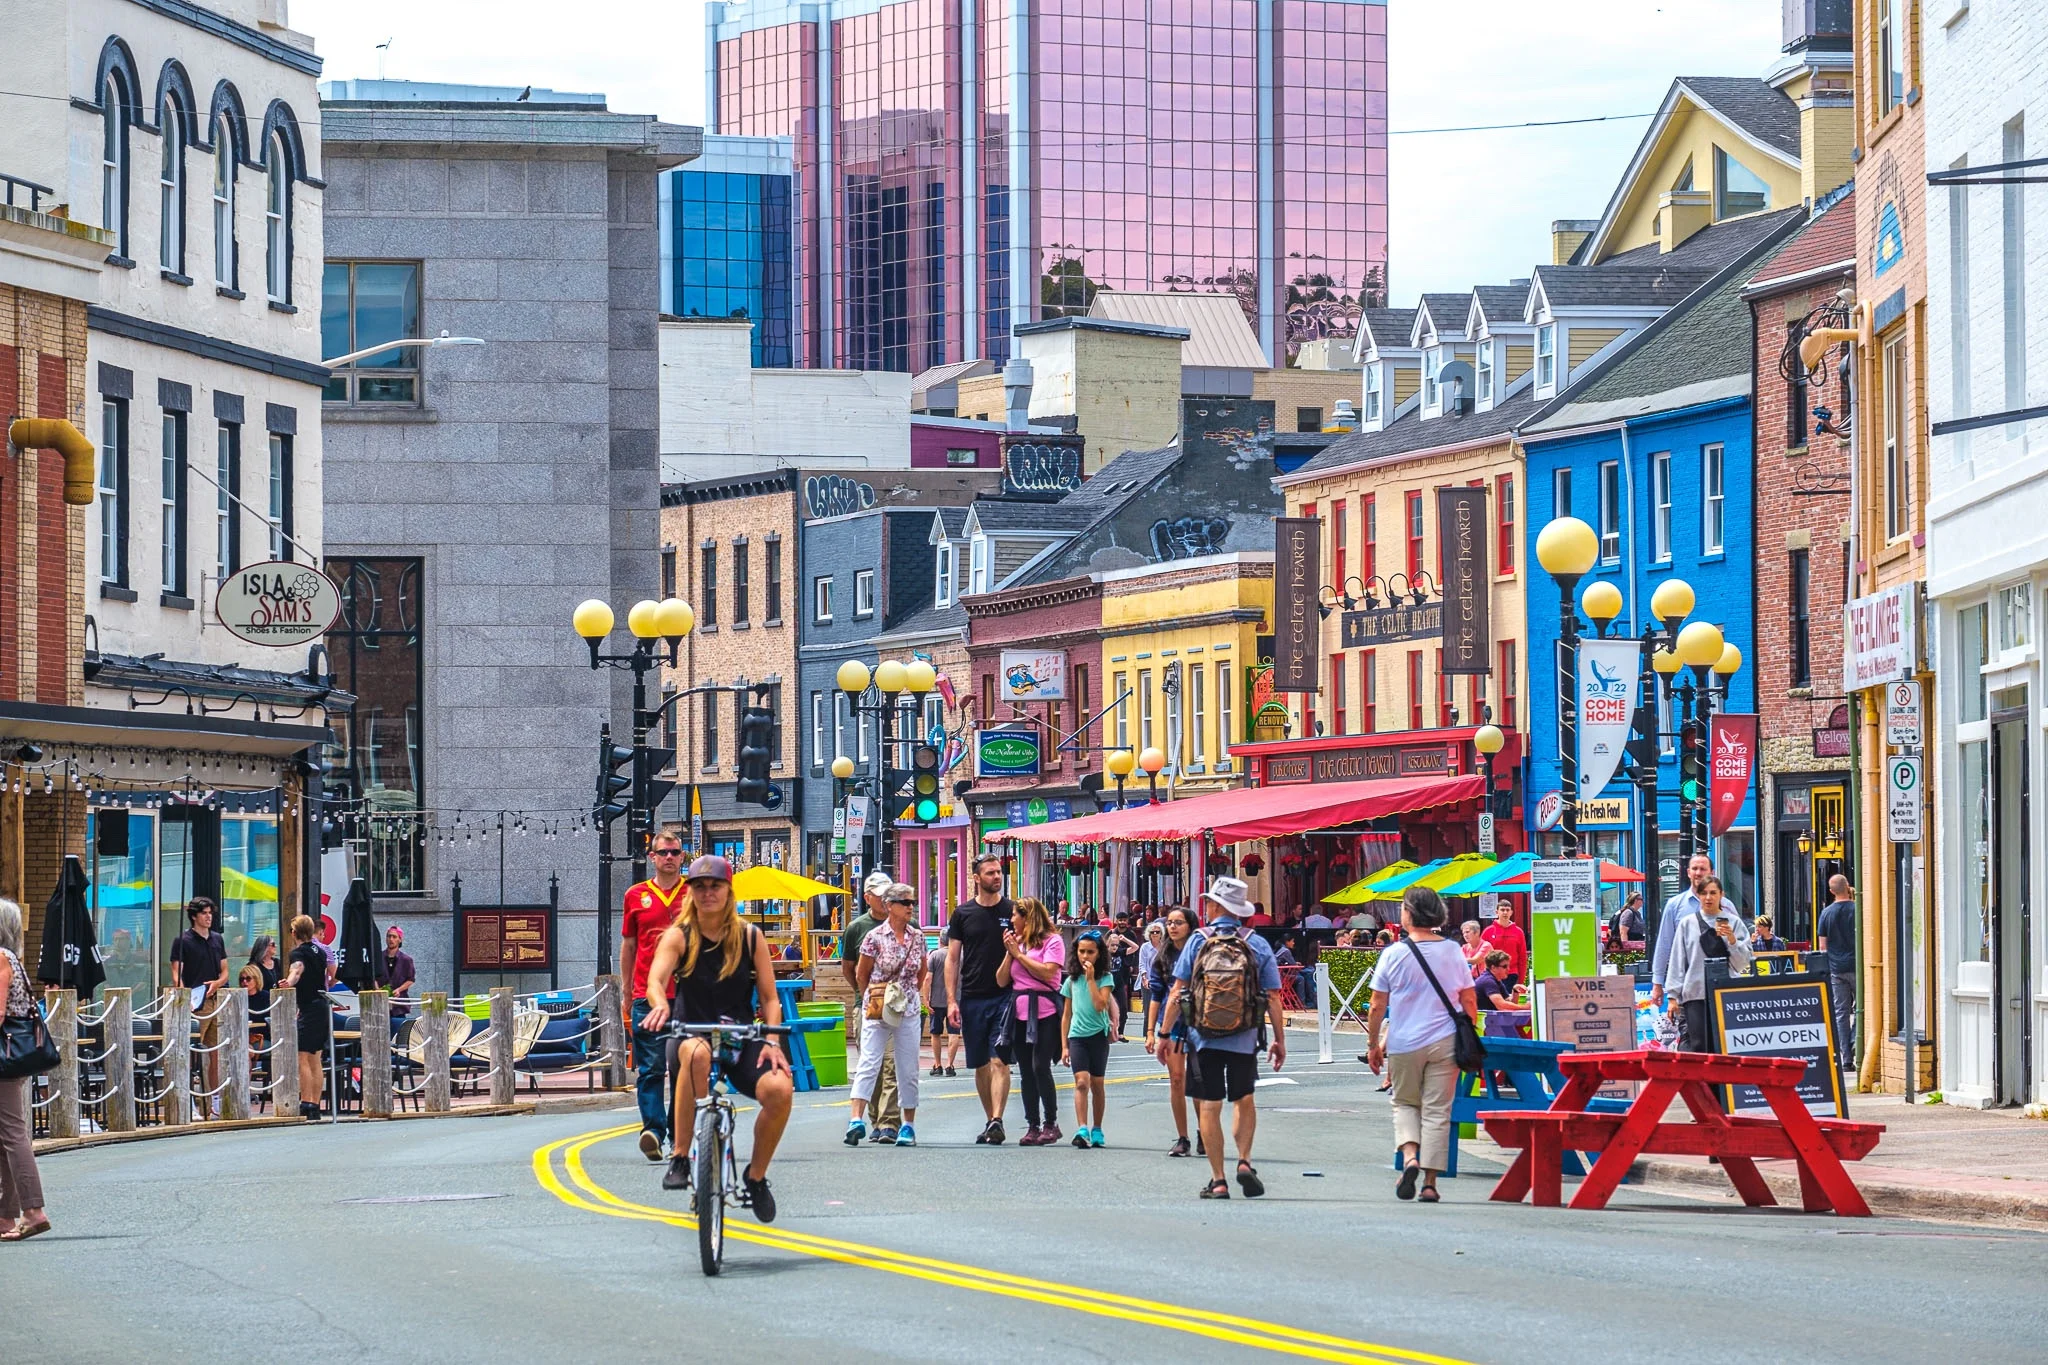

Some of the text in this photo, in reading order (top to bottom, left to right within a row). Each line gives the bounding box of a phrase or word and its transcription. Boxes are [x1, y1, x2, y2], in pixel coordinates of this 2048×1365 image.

[243, 574, 288, 601] ISLA
[251, 594, 312, 628] SAM'S
[1362, 607, 1441, 637] THE CELTIC HEARTH
[246, 626, 311, 635] Shoes & Fashion
[1586, 683, 1627, 692] 20 22
[1585, 699, 1626, 710] COME
[1890, 706, 1917, 714] LOADING ZONE
[1586, 711, 1625, 721] HOME
[1817, 730, 1849, 744] Yellow
[995, 748, 1021, 756] Natural
[1716, 746, 1748, 754] 20 22
[1715, 759, 1747, 768] COME
[1716, 767, 1747, 777] HOME
[1900, 767, 1911, 785] P
[1590, 802, 1606, 819] Fresh
[1606, 802, 1621, 819] Food
[1574, 980, 1606, 991] VIBE
[1726, 997, 1820, 1011] NEWFOUNDLAND
[1736, 1010, 1812, 1022] CANNABIS CO.
[1733, 1028, 1820, 1047] NOW OPEN
